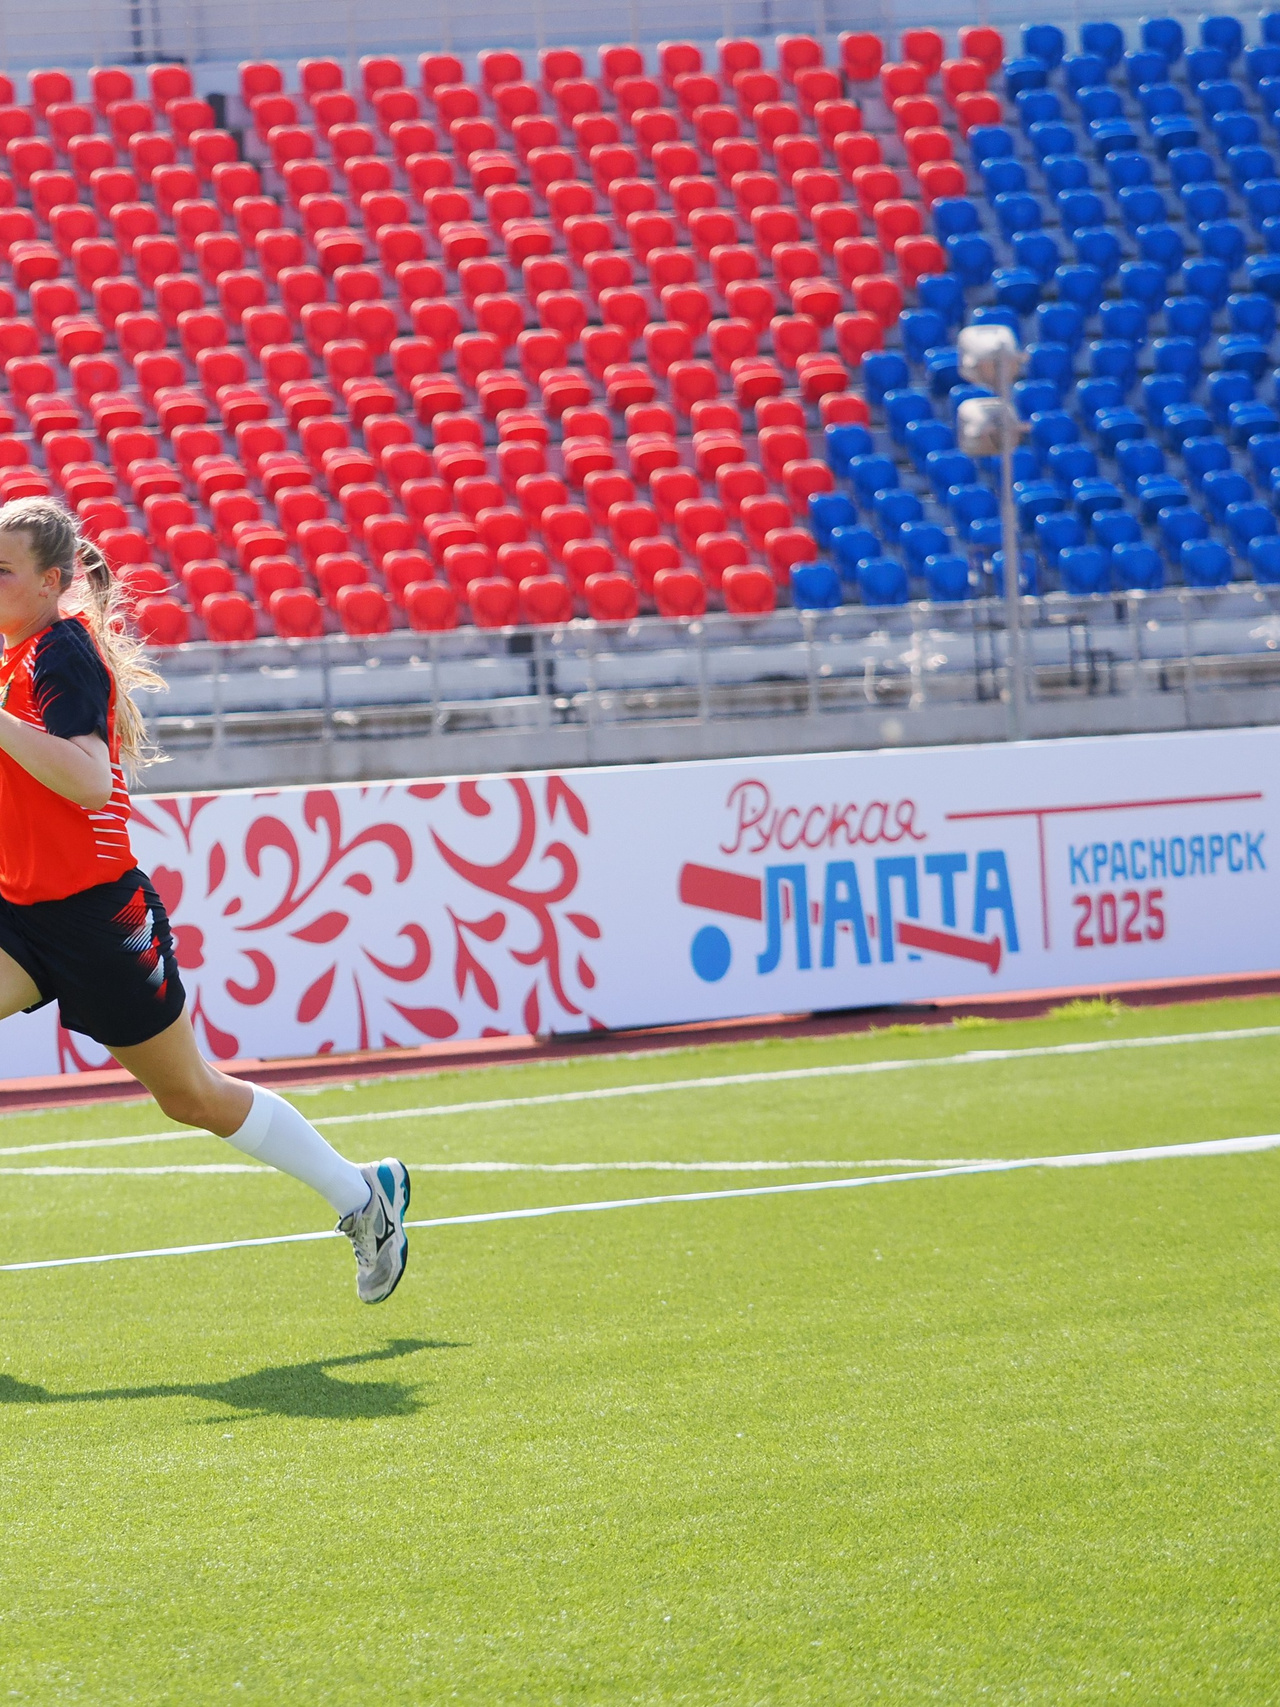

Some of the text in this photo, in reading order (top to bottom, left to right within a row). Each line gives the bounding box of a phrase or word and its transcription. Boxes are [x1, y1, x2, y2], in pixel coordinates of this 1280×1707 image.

[720, 779, 927, 855] Русская
[1068, 831, 1268, 886] КРАСНОЯРСК
[756, 849, 1022, 976] ЛАПТА
[1073, 888, 1166, 948] 2025
